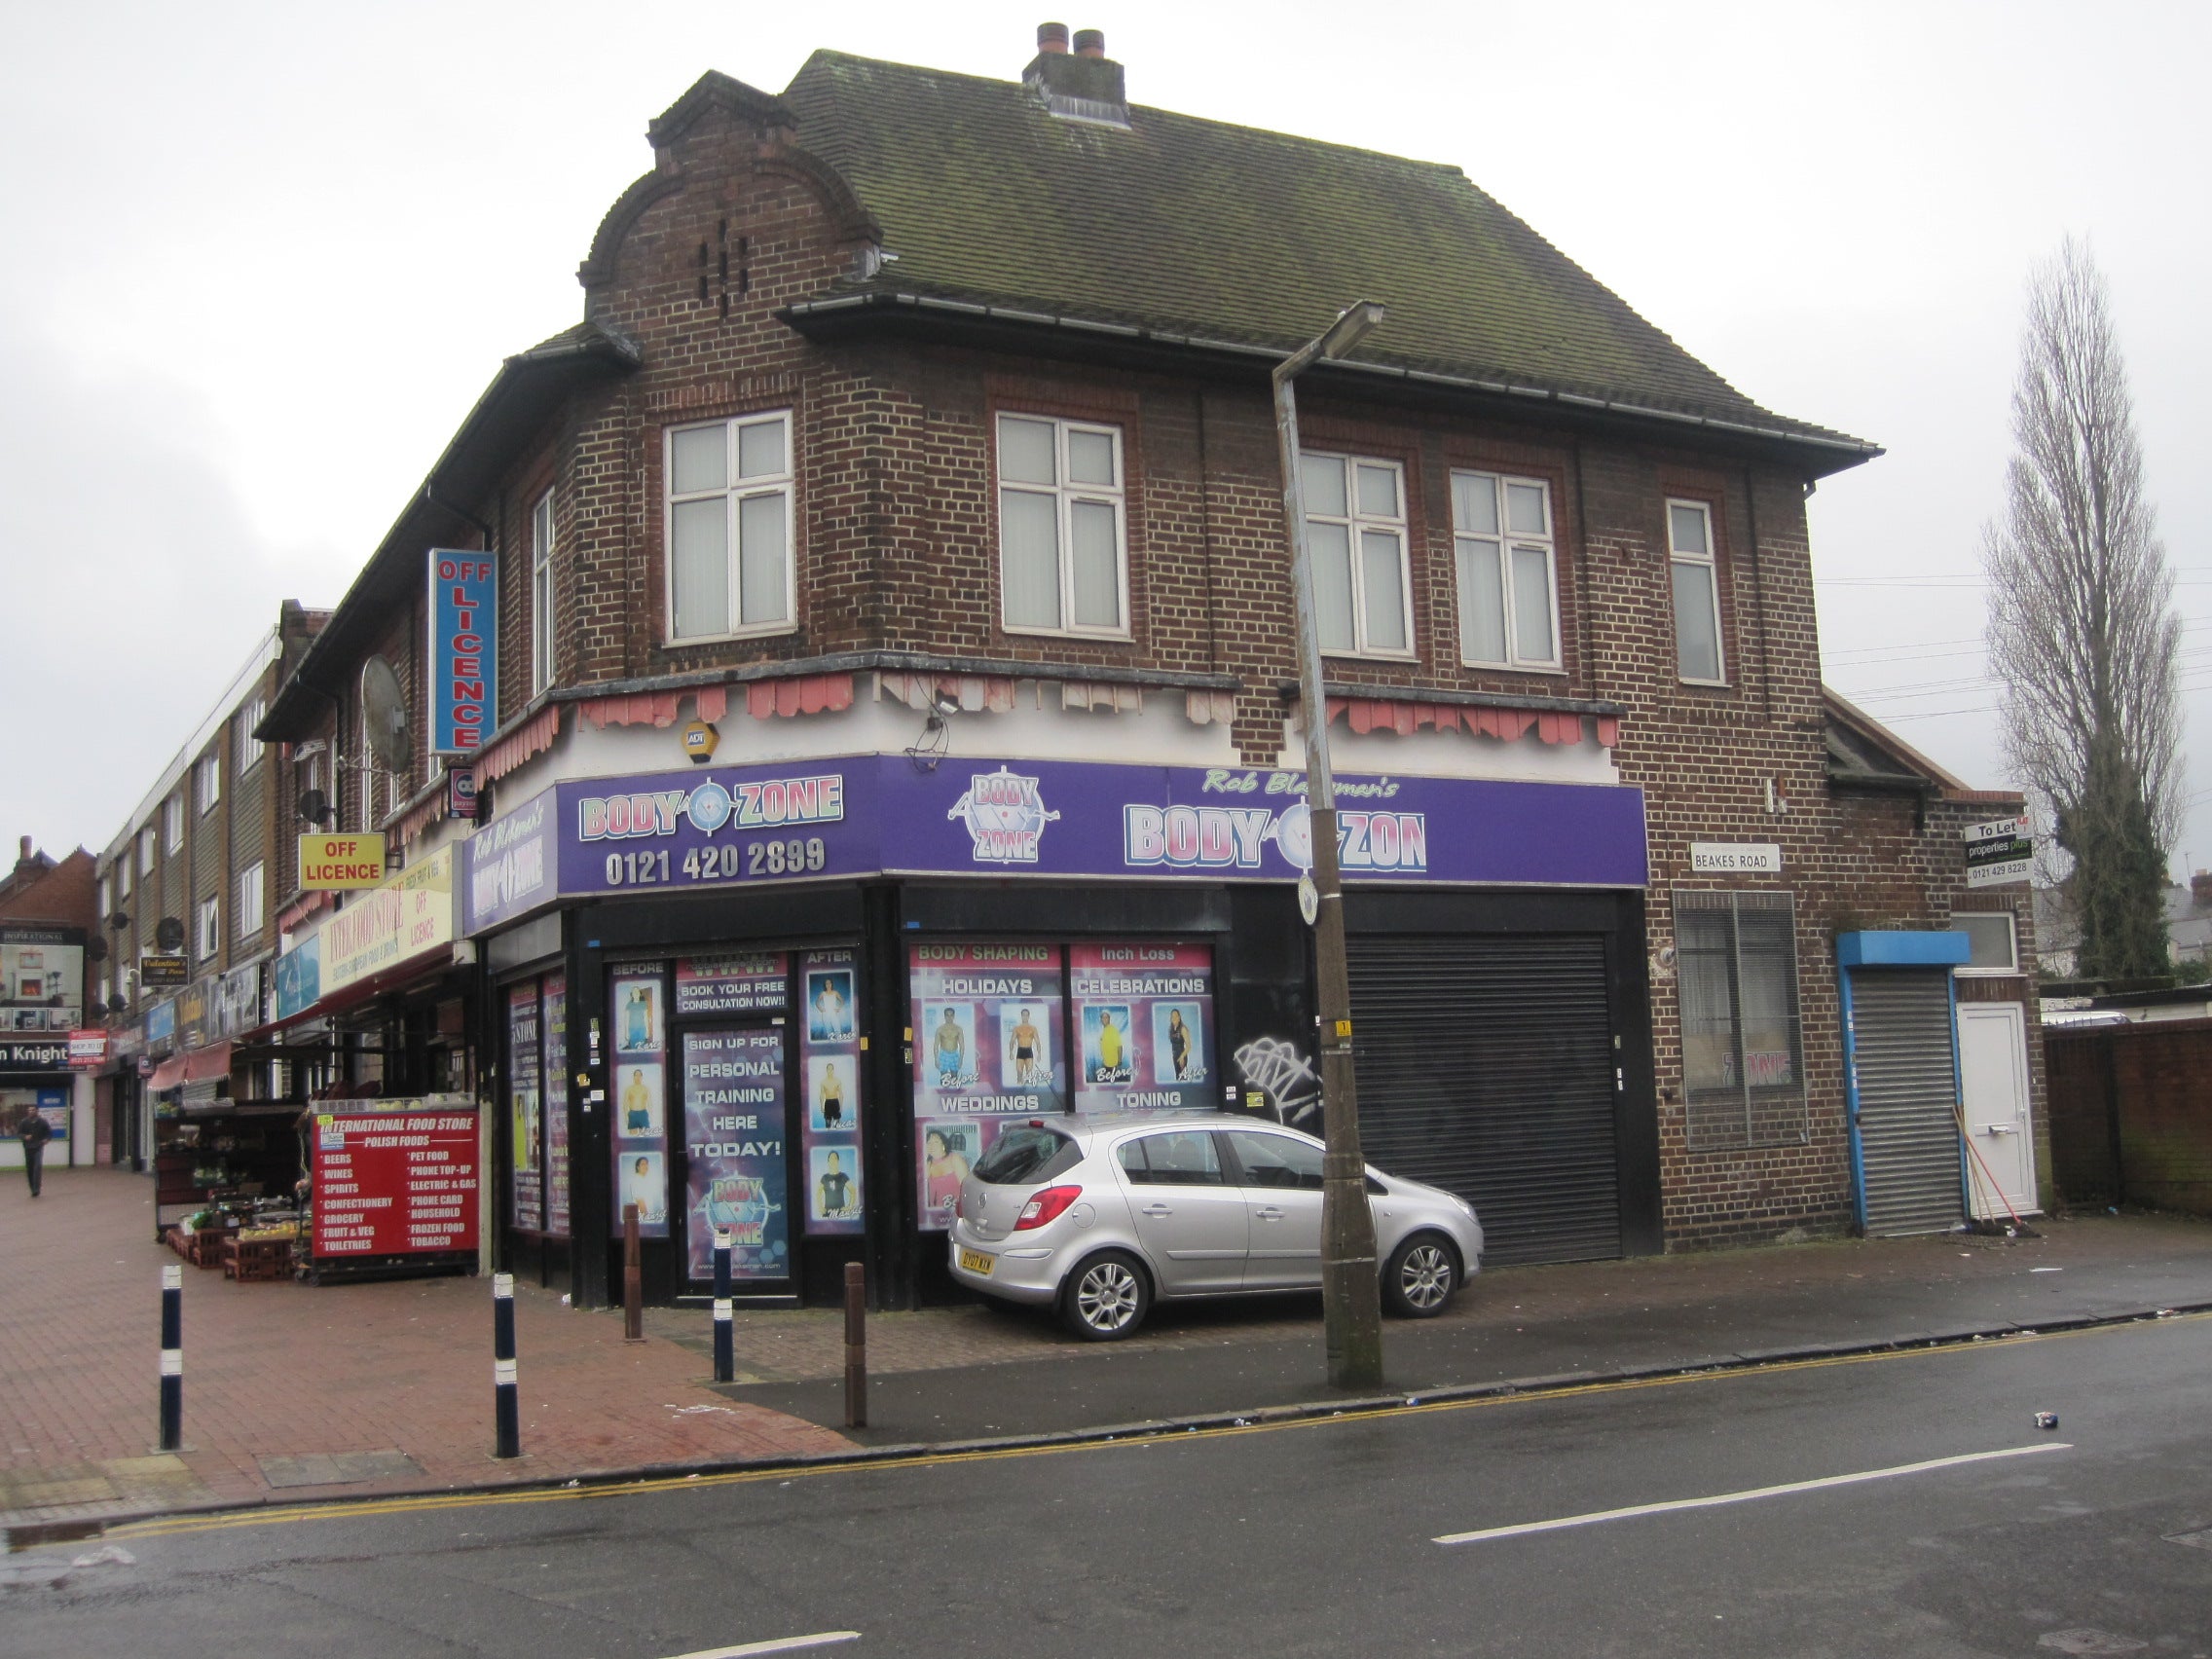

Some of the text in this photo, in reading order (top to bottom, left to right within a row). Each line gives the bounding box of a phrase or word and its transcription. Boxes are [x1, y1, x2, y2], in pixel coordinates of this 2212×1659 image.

[438, 560, 492, 582] OFF
[453, 587, 484, 748] LICENCE
[687, 732, 704, 745] ADT
[972, 775, 1039, 805] BODY
[1201, 769, 1400, 797] Rob Blaman's
[579, 775, 843, 841] BODY ZONE
[1124, 804, 1272, 867] BODY
[1978, 826, 1992, 836] To
[1997, 822, 2016, 833] Let
[325, 841, 357, 857] OFF
[974, 830, 1038, 862] ZONE
[1969, 841, 2009, 858] properties
[2010, 839, 2028, 852] plus
[606, 838, 825, 885] 0121 420 2899
[1695, 855, 1767, 867] BEAKES ROAD
[307, 864, 380, 880] LICENCE
[1972, 863, 2027, 879] 0121 429 8228
[416, 890, 427, 914] OFF
[410, 916, 434, 946] LICENCE
[807, 950, 852, 964] AFTER
[918, 946, 1049, 960] BODY SHAPING
[1101, 946, 1174, 960] Inch Loss
[613, 962, 664, 976] BEFORE
[682, 981, 785, 996] BOOK YOUR FREE
[941, 978, 1032, 994] HOLIDAYS
[1077, 978, 1205, 994] CELEBRATIONS
[682, 996, 785, 1011] CONSULTATION NOW!!
[688, 1036, 778, 1050] SIGN UP FOR
[14, 1047, 67, 1063] Knight
[689, 1061, 779, 1078] PERSONAL
[1096, 1068, 1133, 1083] Before
[1178, 1066, 1208, 1082] After
[940, 1071, 979, 1088] Before
[695, 1088, 774, 1104] TRAINING
[940, 1095, 1039, 1112] WEDDINGS
[1117, 1091, 1181, 1108] TONING
[320, 1119, 405, 1134] INTERNATIONAL
[407, 1119, 436, 1131] FOOD
[438, 1118, 473, 1129] STORE
[713, 1116, 757, 1130] HERE
[364, 1135, 429, 1148] POLISH FOODS
[410, 1151, 449, 1161] PET FOOD
[690, 1142, 780, 1158] TODAY!
[324, 1155, 351, 1164] BEERS
[324, 1169, 352, 1179] WINES
[411, 1165, 471, 1175] PHONE TOP-UP
[324, 1183, 359, 1194] SPIRITS
[410, 1180, 449, 1190] ELECTRIC
[460, 1179, 476, 1189] GAS
[710, 1178, 764, 1202] BODY
[324, 1198, 393, 1209] CONFECTIONERY
[411, 1195, 463, 1205] PHONE CARD
[324, 1214, 364, 1224] GROCERY
[411, 1207, 460, 1218] HOUSEHOLD
[324, 1227, 349, 1237] FRUIT
[358, 1226, 375, 1236] VEG
[411, 1223, 464, 1234] FROZEN FOOD
[324, 1240, 372, 1251] TOILETRIES
[412, 1235, 451, 1246] TOBACCO
